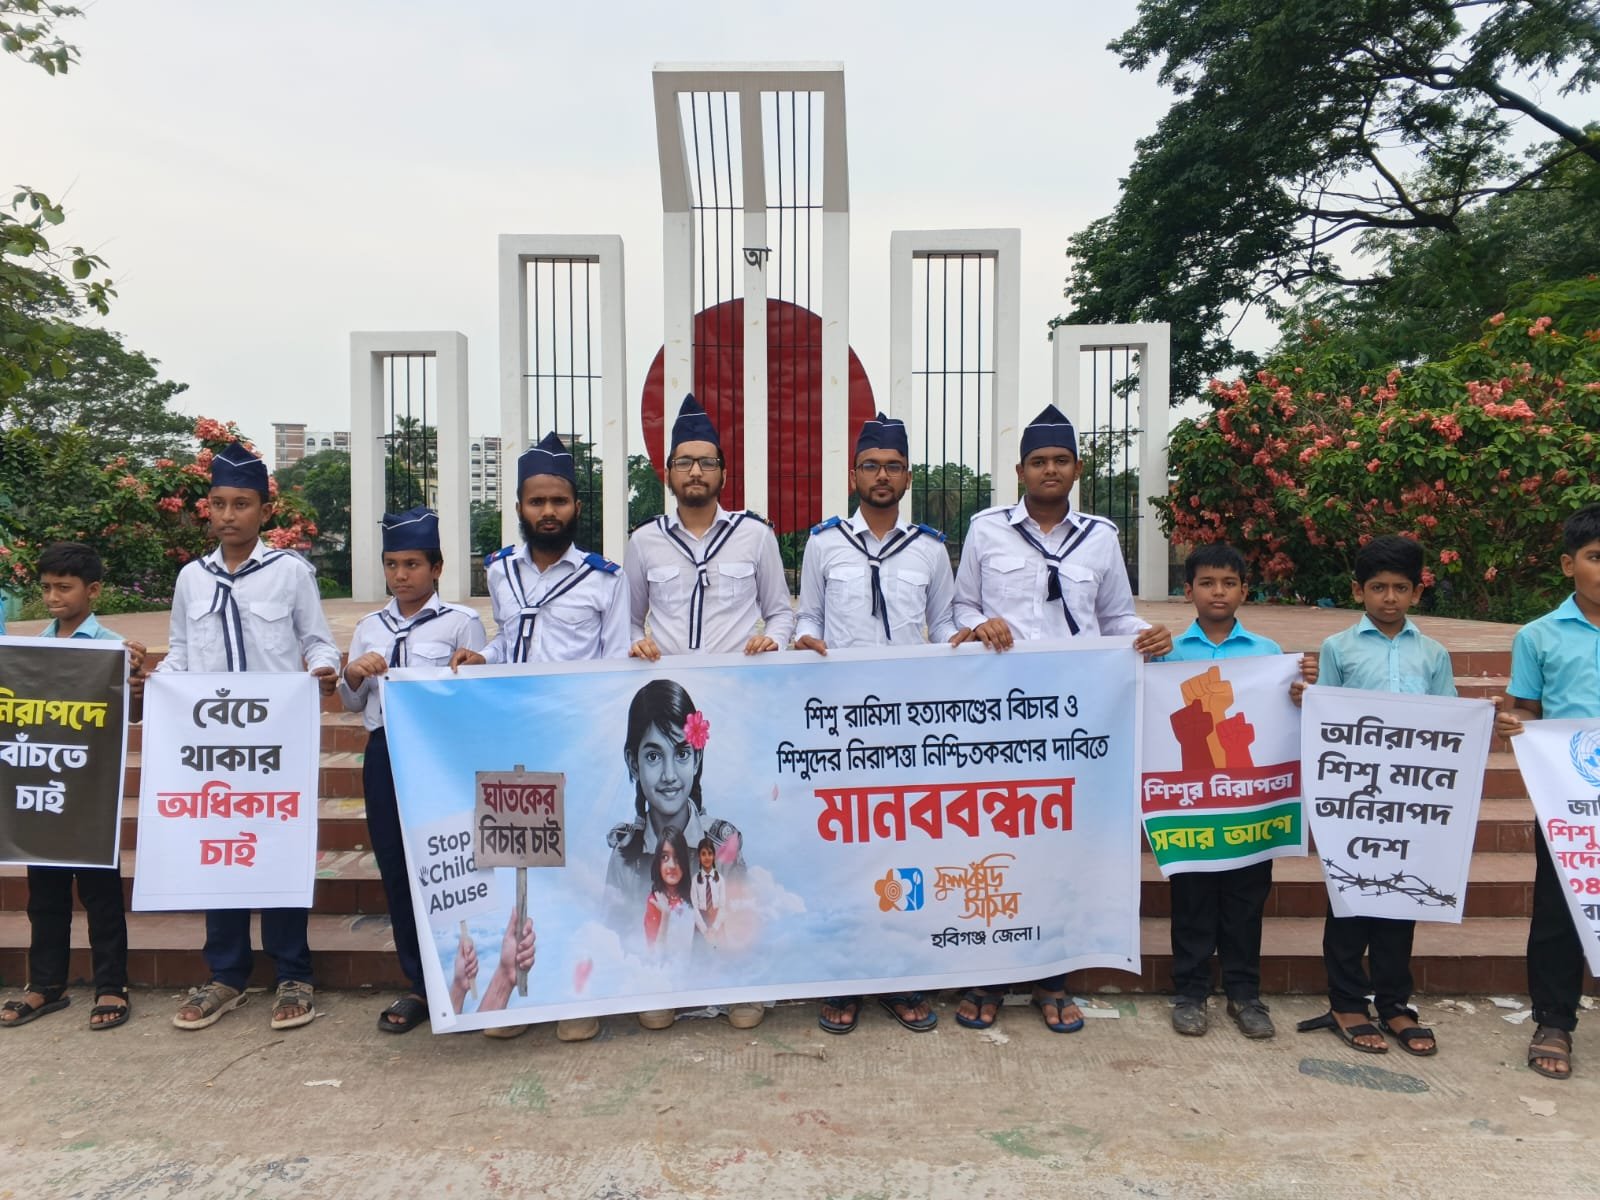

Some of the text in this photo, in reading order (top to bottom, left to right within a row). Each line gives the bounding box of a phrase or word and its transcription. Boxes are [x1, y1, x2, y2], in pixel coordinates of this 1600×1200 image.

[193, 688, 269, 728] বেঁচে
[805, 688, 1078, 736] শিশু রামিসা হত্যাকাণ্ডের বিচার ও
[1321, 716, 1465, 752] অনিরাপদ
[0, 732, 88, 772] বাঁচতে
[181, 745, 282, 774] থাকার
[777, 728, 1109, 780] শিশুদের নিরাপত্তা নিশ্চিতকরণের দাবিতে
[1144, 773, 1294, 806] শিশুর নিরাপত্তা
[1317, 751, 1458, 795] শিশু মানে
[16, 780, 66, 814] চাই
[157, 781, 300, 821] অধিকার
[482, 780, 557, 815] ঘাতকের
[815, 777, 1075, 843] মানববন্ধন
[1315, 790, 1453, 825] অনিরাপদ
[200, 832, 257, 867] চাই
[428, 831, 470, 856] Stop
[479, 815, 561, 857] বিচার চাই
[1151, 815, 1292, 851] সবার আগে
[1347, 836, 1410, 860] দেশ
[430, 852, 478, 884] Child
[430, 882, 488, 914] Abuse
[931, 927, 986, 948] হবিগঞ্জ
